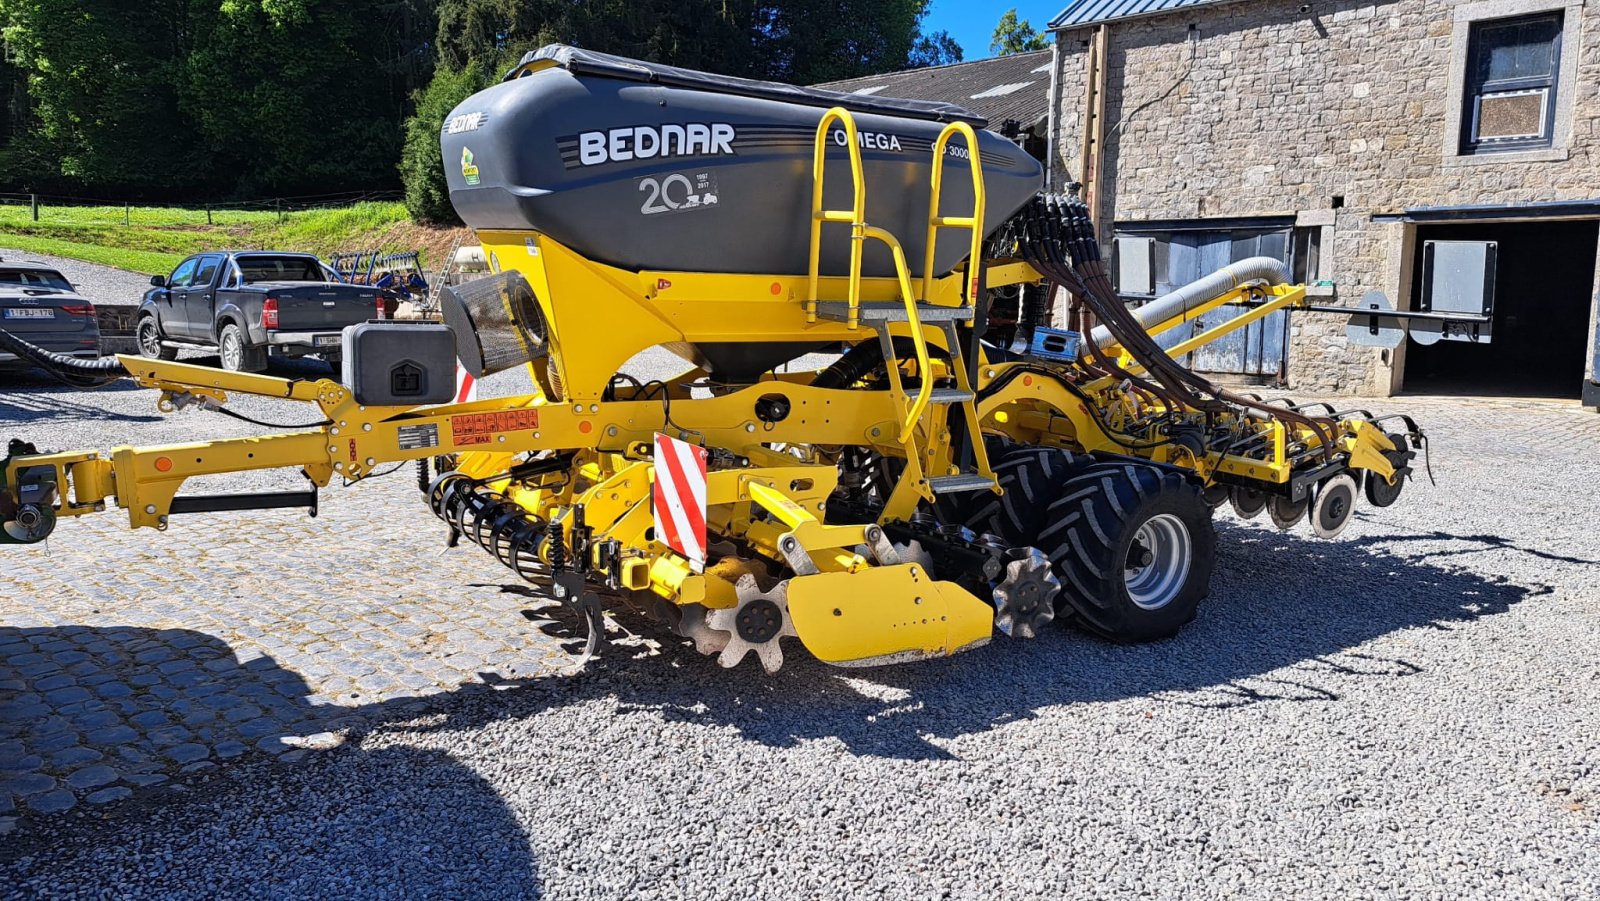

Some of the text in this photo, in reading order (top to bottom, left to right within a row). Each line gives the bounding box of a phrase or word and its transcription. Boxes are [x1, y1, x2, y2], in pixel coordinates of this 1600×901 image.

[580, 124, 735, 166] BEDNAR
[949, 145, 969, 159] 3000
[639, 173, 693, 215] 20
[474, 436, 491, 445] MAX
